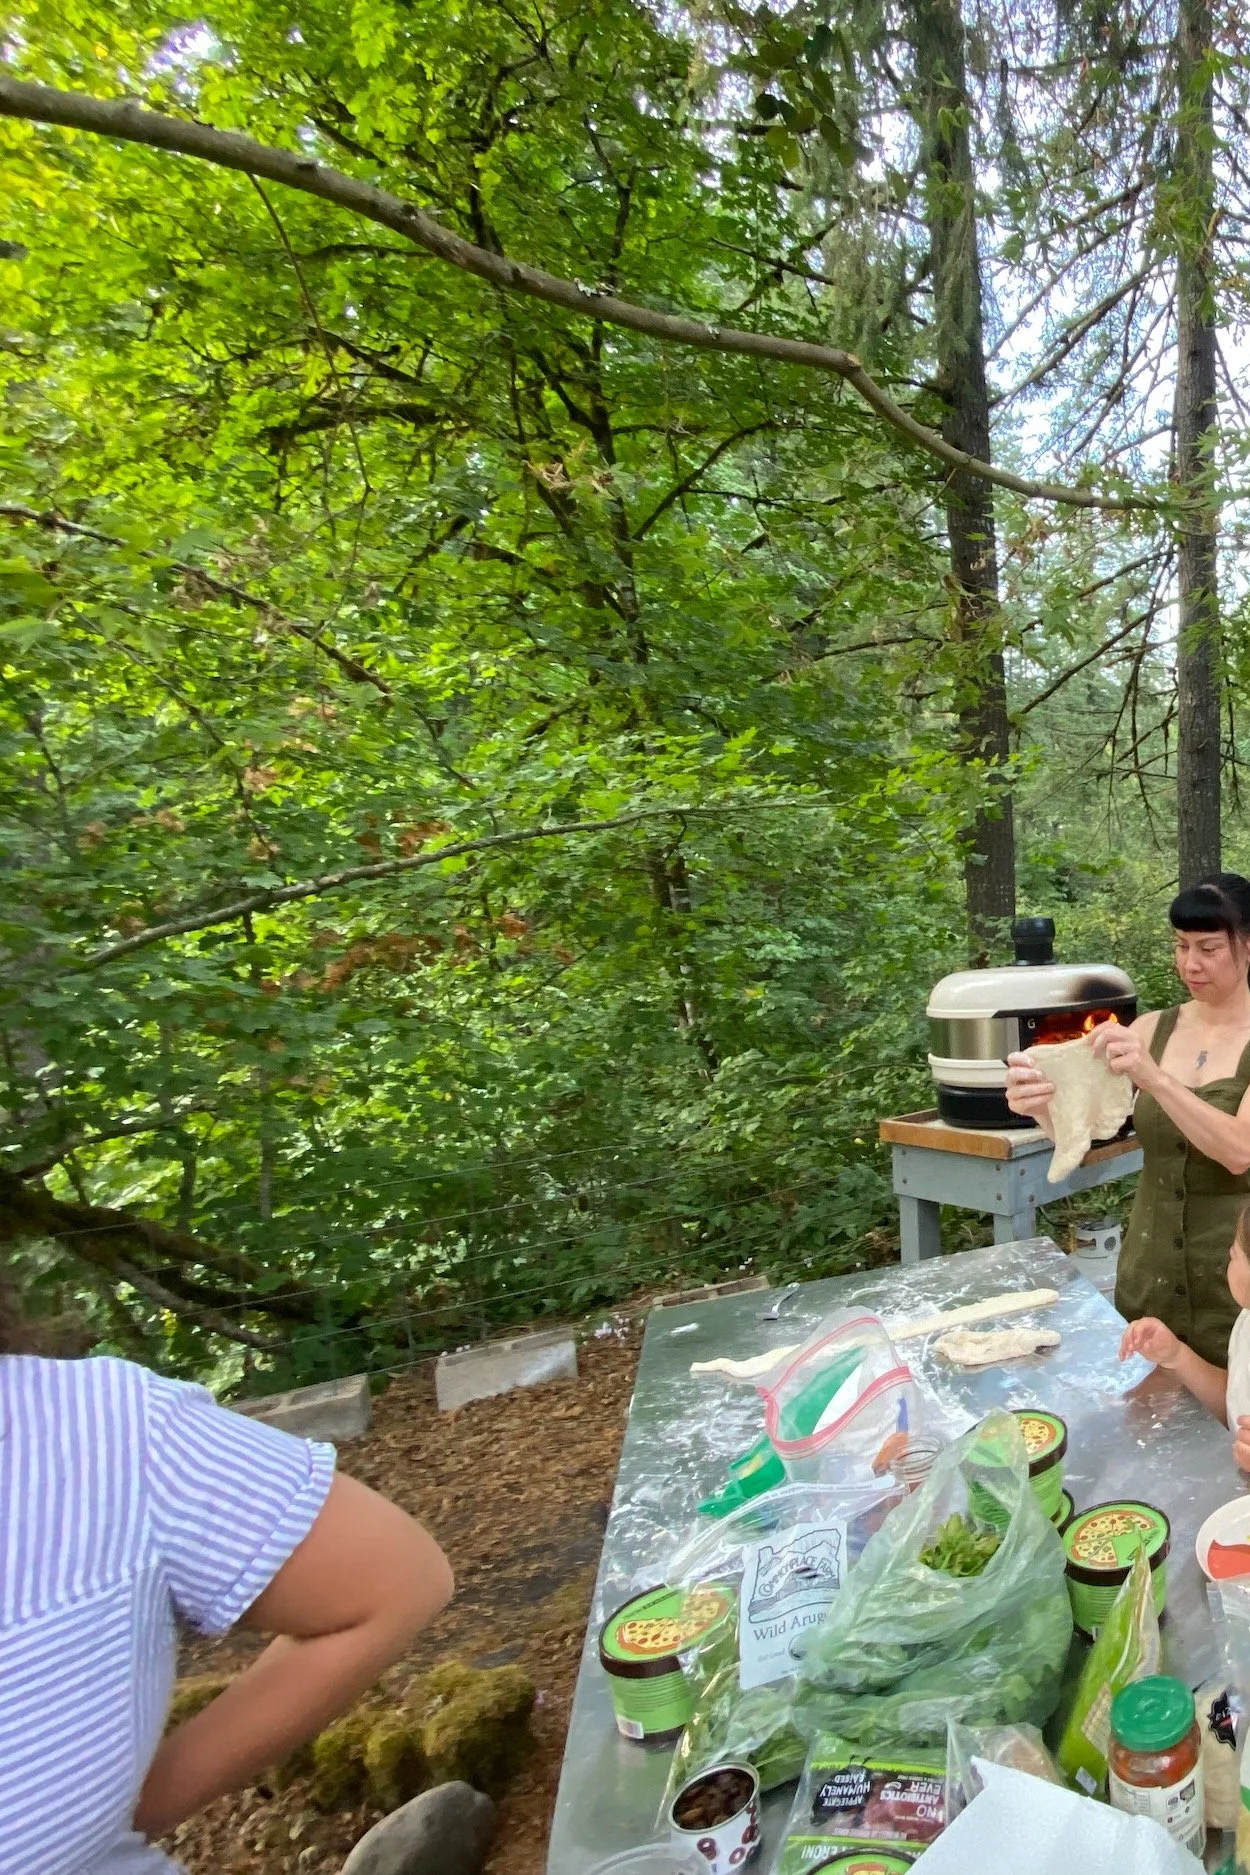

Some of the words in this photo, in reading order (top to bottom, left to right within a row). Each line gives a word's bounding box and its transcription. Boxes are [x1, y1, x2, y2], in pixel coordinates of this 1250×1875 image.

[759, 1556, 817, 1597] COMMONPLACE
[753, 1620, 786, 1641] Wild
[791, 1611, 827, 1629] Arug
[819, 1781, 871, 1797] HUMANELY
[910, 1781, 941, 1794] EVER
[822, 1795, 864, 1807] APPLEGATE
[880, 1790, 940, 1805] ANTIBIOTICS
[916, 1805, 938, 1819] NO
